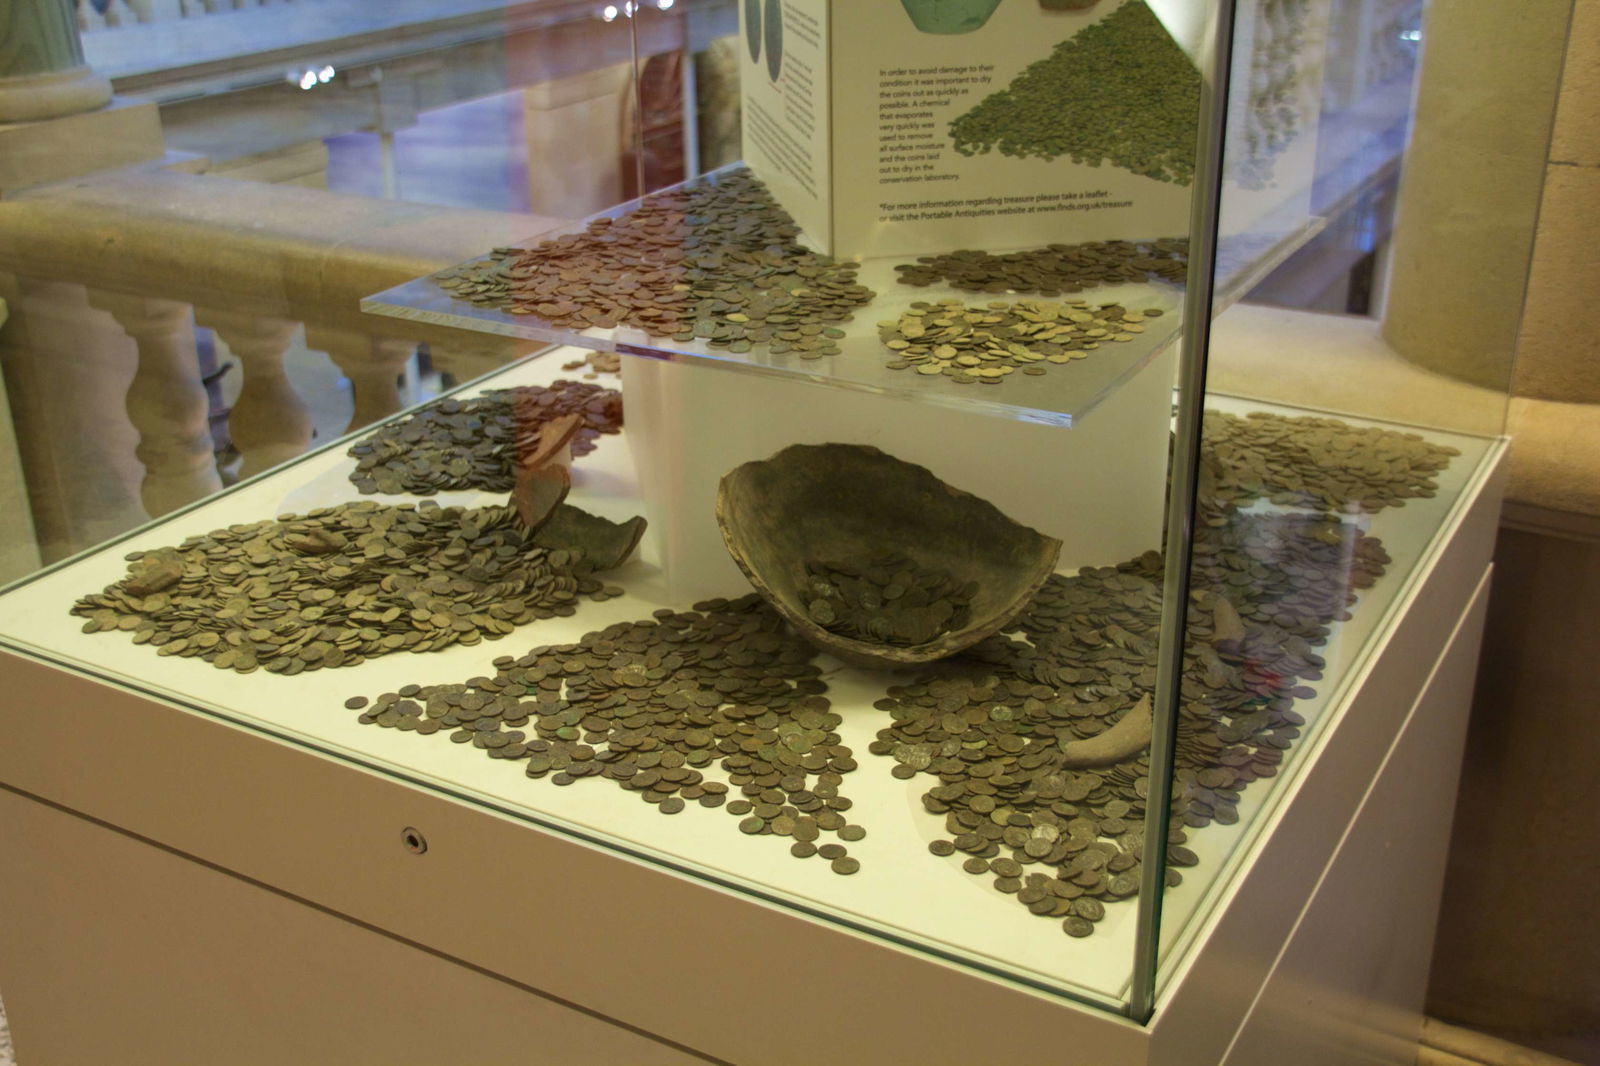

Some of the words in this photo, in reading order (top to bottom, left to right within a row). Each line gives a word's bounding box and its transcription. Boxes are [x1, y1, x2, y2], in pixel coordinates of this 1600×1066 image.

[879, 69, 887, 77] In
[887, 68, 907, 76] order
[918, 66, 938, 75] avoid
[939, 66, 968, 75] damage
[978, 64, 994, 72] their
[880, 79, 912, 88] condition
[935, 76, 969, 86] important
[979, 74, 991, 85] dry
[892, 90, 911, 98] coins
[935, 87, 959, 97] quickly
[880, 101, 908, 111] possible.
[919, 98, 950, 106] chemical
[880, 112, 893, 120] that
[894, 111, 933, 121] evaporates
[880, 124, 894, 132] very
[895, 122, 920, 132] quickly
[889, 143, 913, 151] surface
[879, 155, 892, 163] and
[894, 154, 906, 162] the
[926, 152, 940, 160] laid
[901, 164, 912, 174] dry
[879, 175, 922, 184] conservation
[924, 174, 959, 183] laboratory.
[896, 203, 917, 211] more
[919, 199, 964, 209] information
[965, 196, 1002, 208] regarding
[1003, 196, 1035, 204] treasure
[1036, 192, 1060, 204] please
[1061, 191, 1078, 200] take
[1085, 189, 1108, 199] leaflet
[890, 212, 905, 222] visit
[906, 212, 919, 221] the
[921, 210, 953, 220] Portable
[954, 207, 996, 219] Antiquities
[996, 206, 1026, 216] website
[1027, 206, 1035, 214] at
[1036, 200, 1133, 213] www.finds.org.uk/treasure
